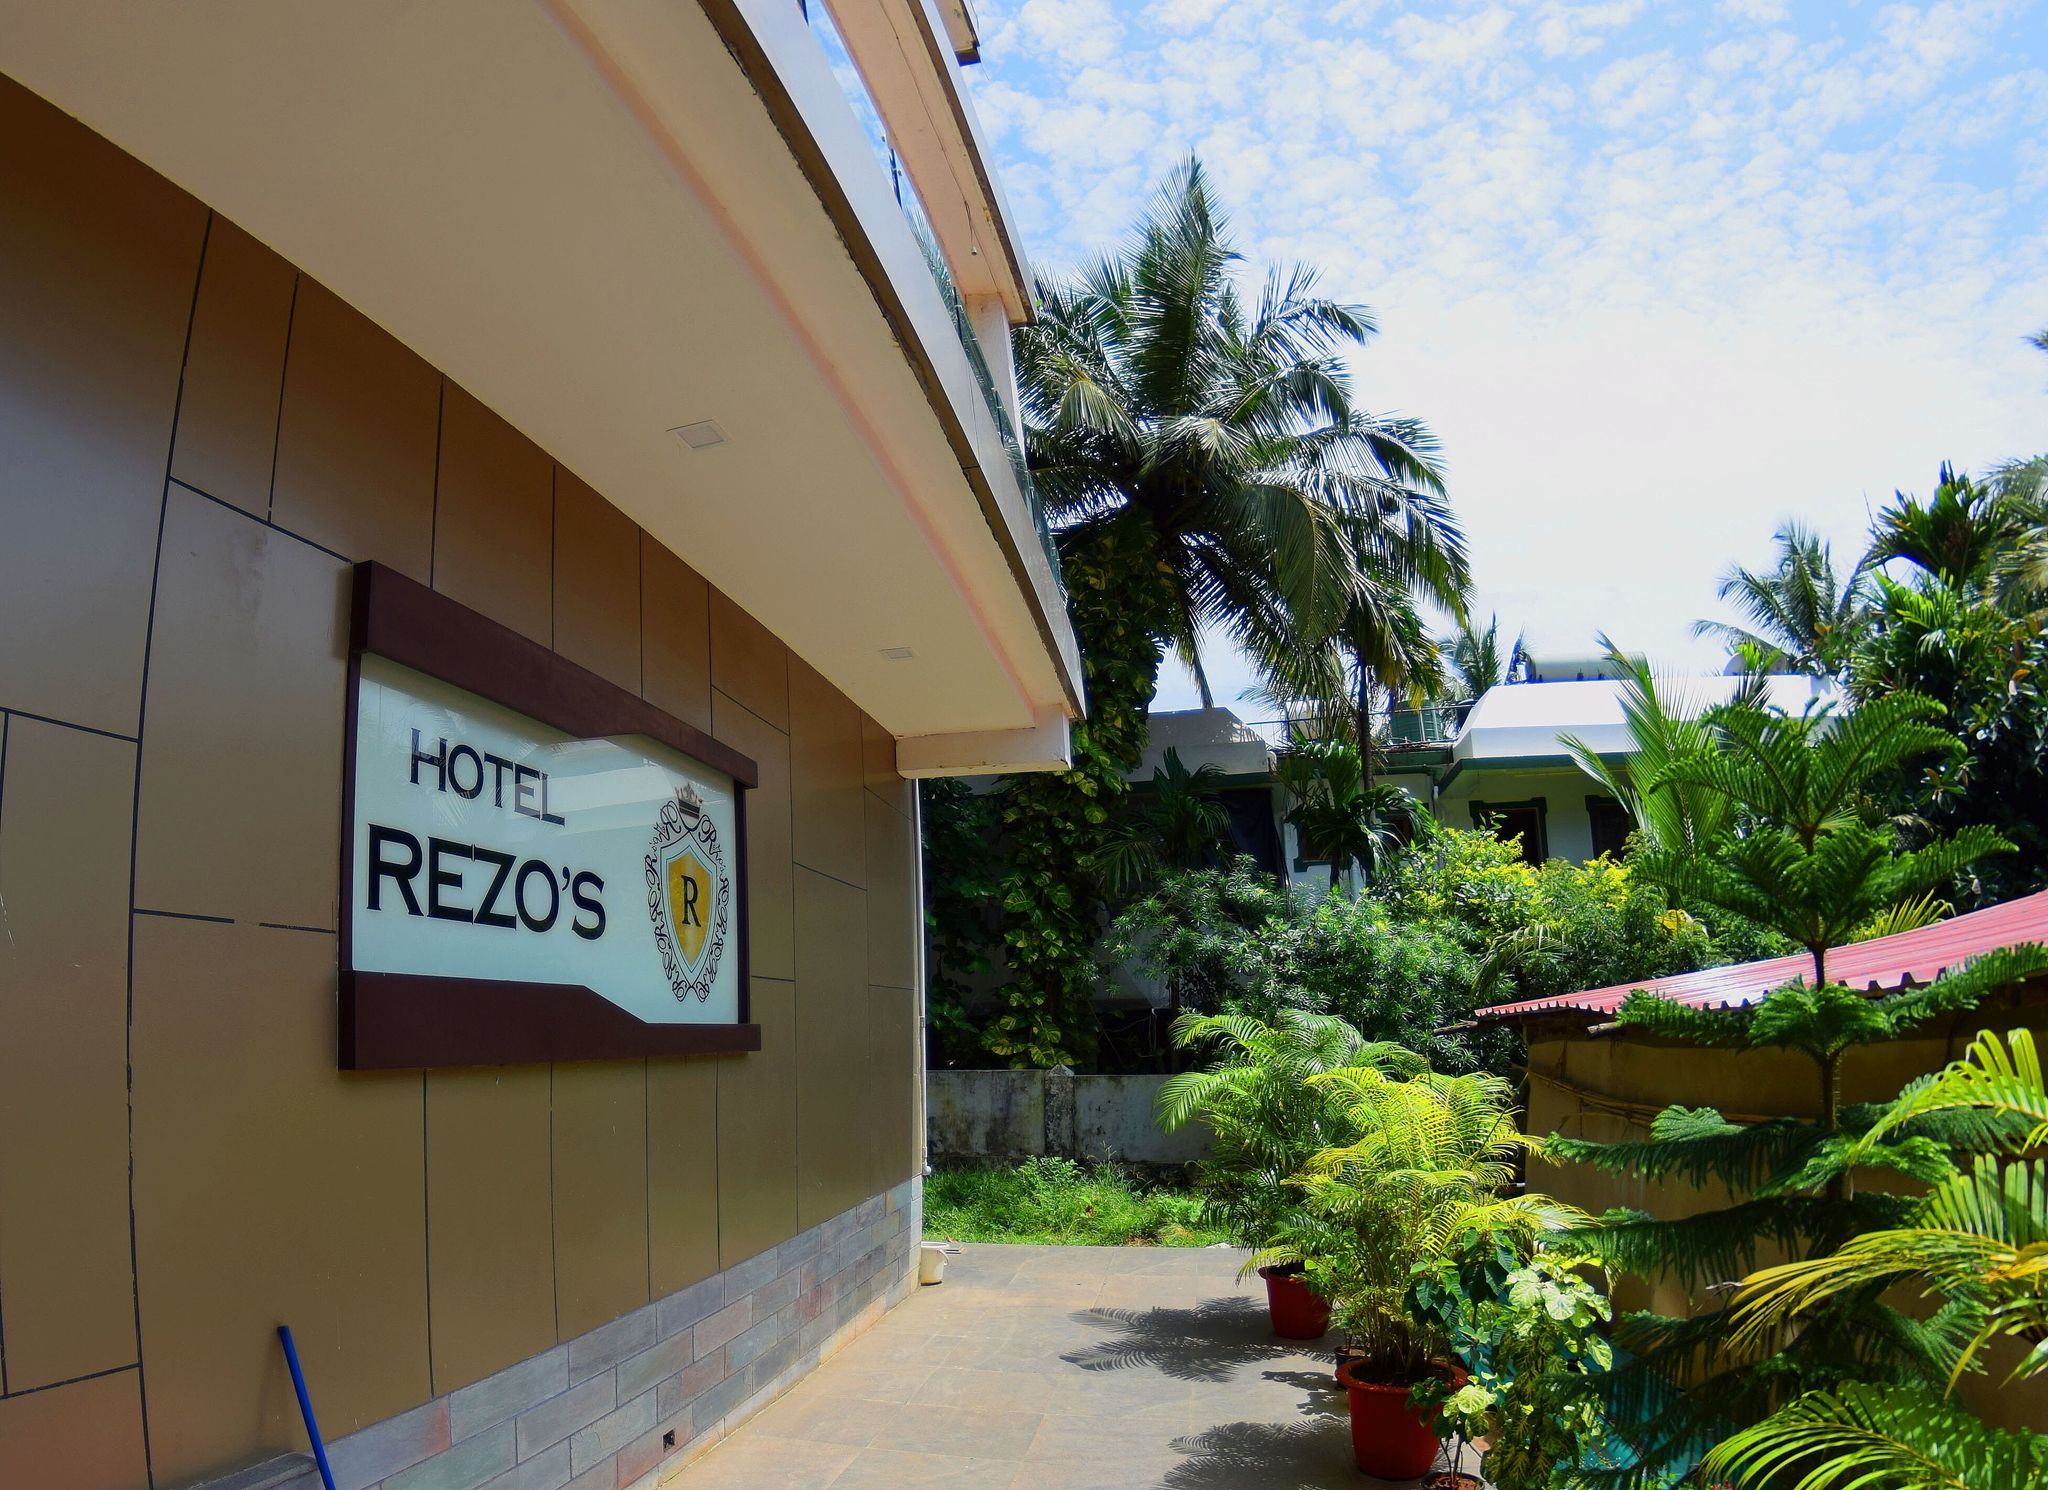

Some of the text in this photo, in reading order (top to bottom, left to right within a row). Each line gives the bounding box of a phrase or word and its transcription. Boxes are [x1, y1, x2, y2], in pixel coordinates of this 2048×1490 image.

[410, 728, 566, 826] HOTEL
[366, 823, 607, 941] REZO'S
[681, 874, 702, 928] R
